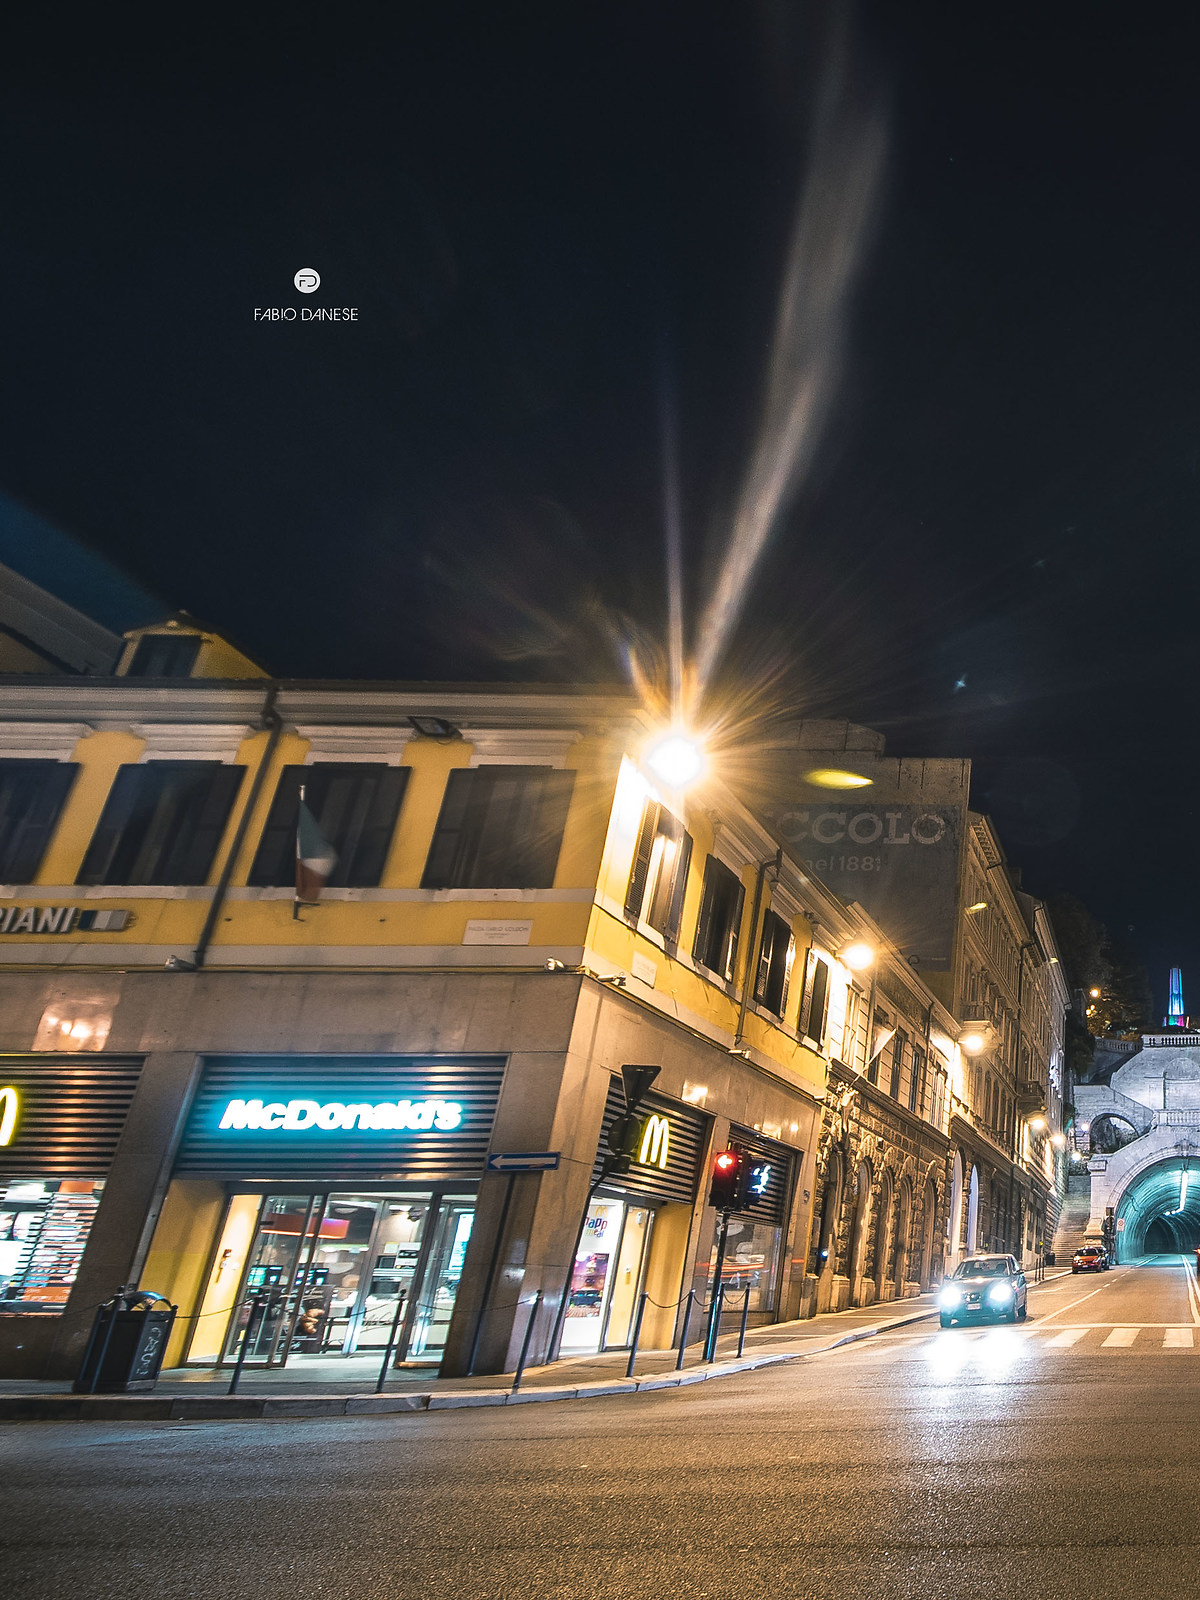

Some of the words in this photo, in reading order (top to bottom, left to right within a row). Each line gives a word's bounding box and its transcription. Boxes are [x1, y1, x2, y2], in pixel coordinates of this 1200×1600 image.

[764, 811, 946, 844] CCOLO
[0, 907, 77, 932] IANI
[218, 1099, 463, 1130] McDonald's
